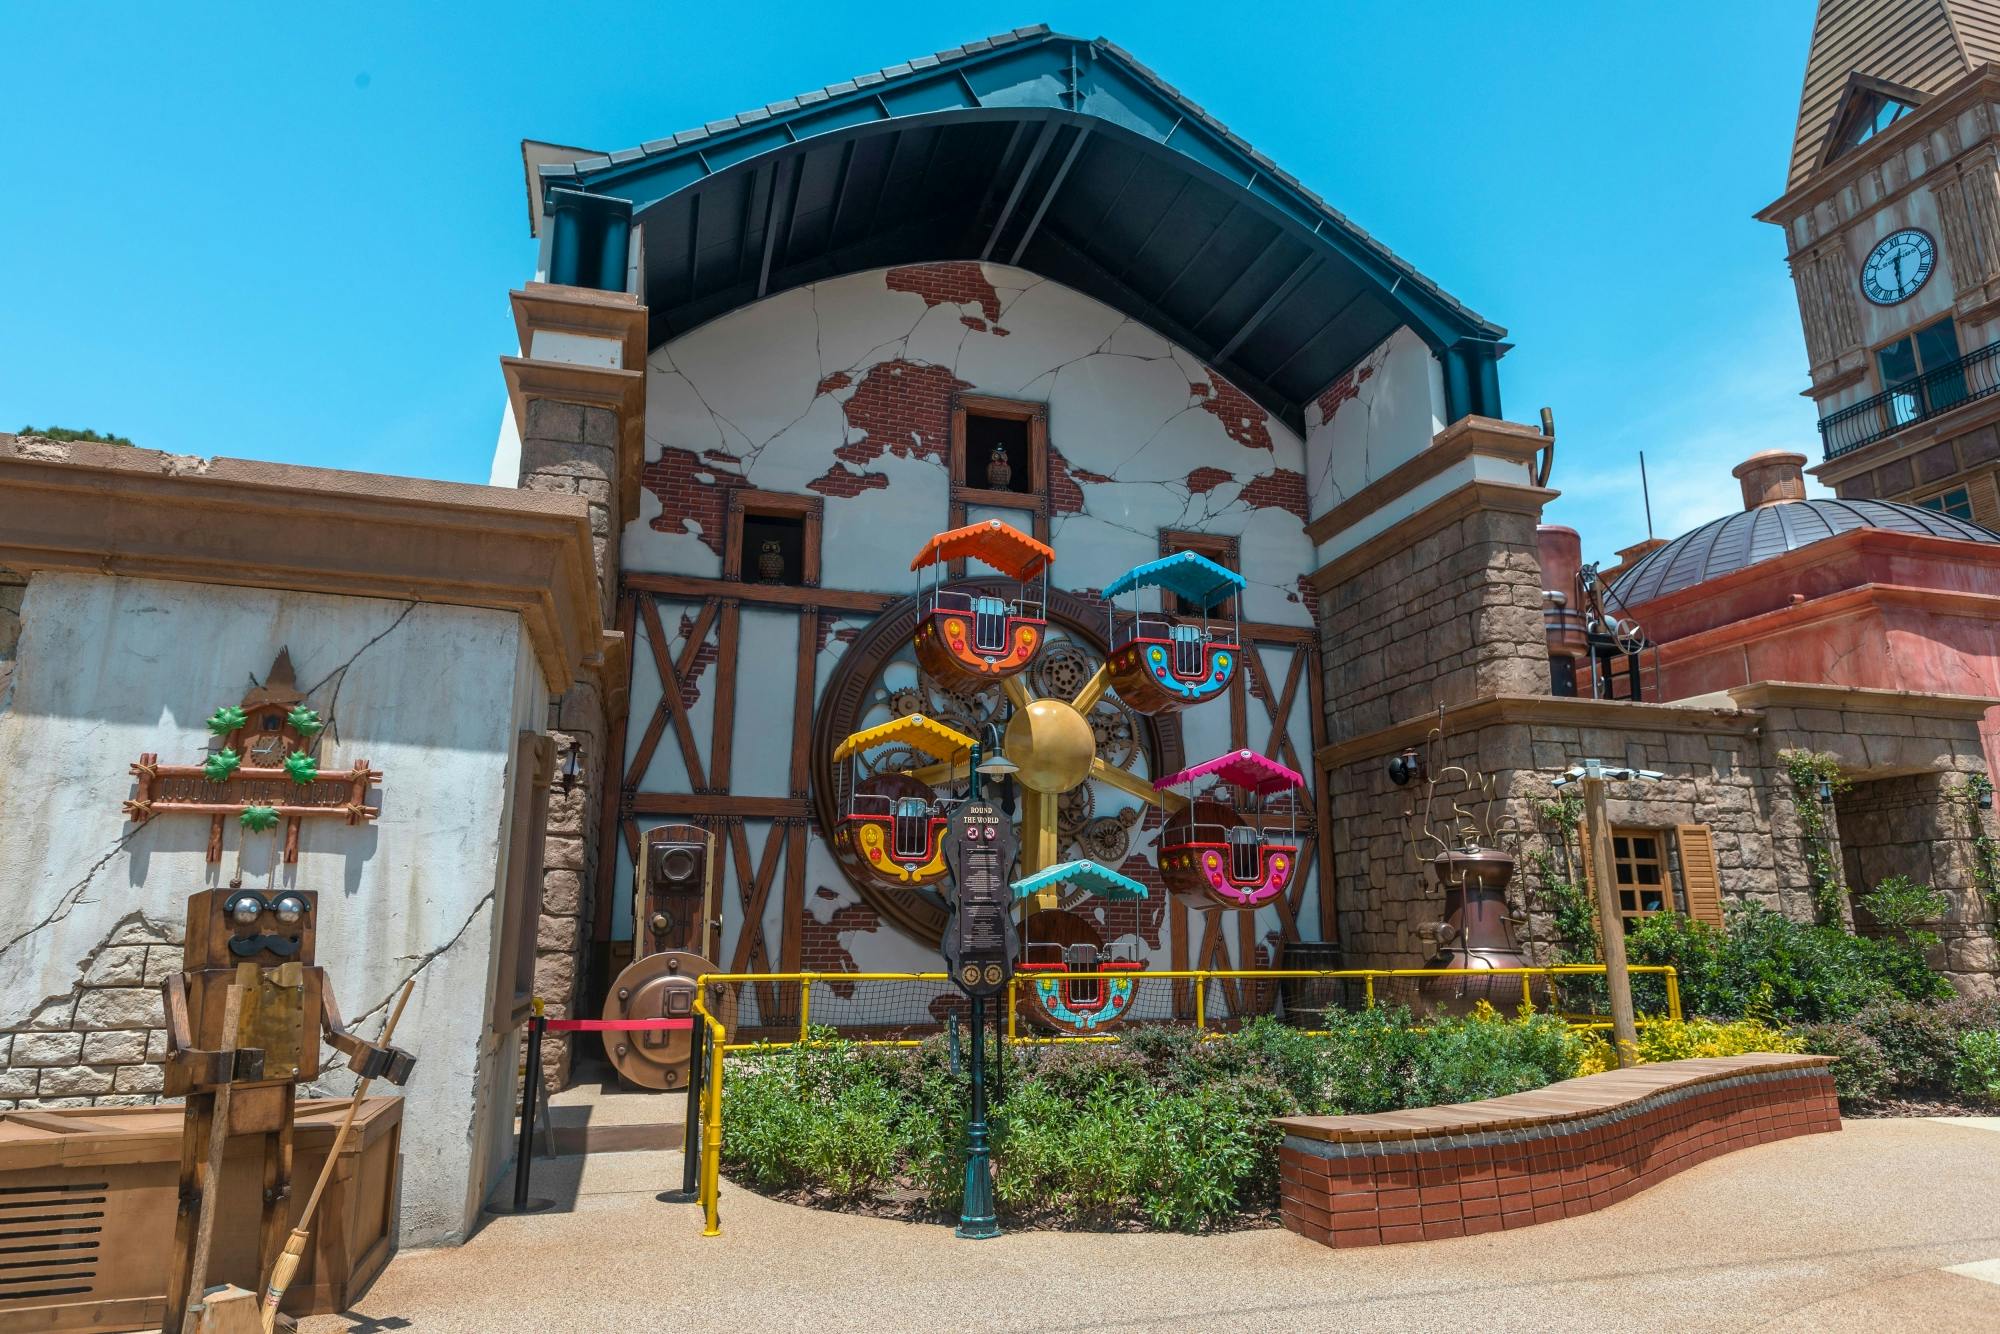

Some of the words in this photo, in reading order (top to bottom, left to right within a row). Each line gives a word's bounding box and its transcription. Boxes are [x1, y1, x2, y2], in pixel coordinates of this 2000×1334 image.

[161, 777, 232, 801] ROUND
[240, 779, 276, 804] THE
[970, 806, 993, 814] ROUND
[963, 816, 976, 824] THE
[977, 816, 999, 824] WORLD
